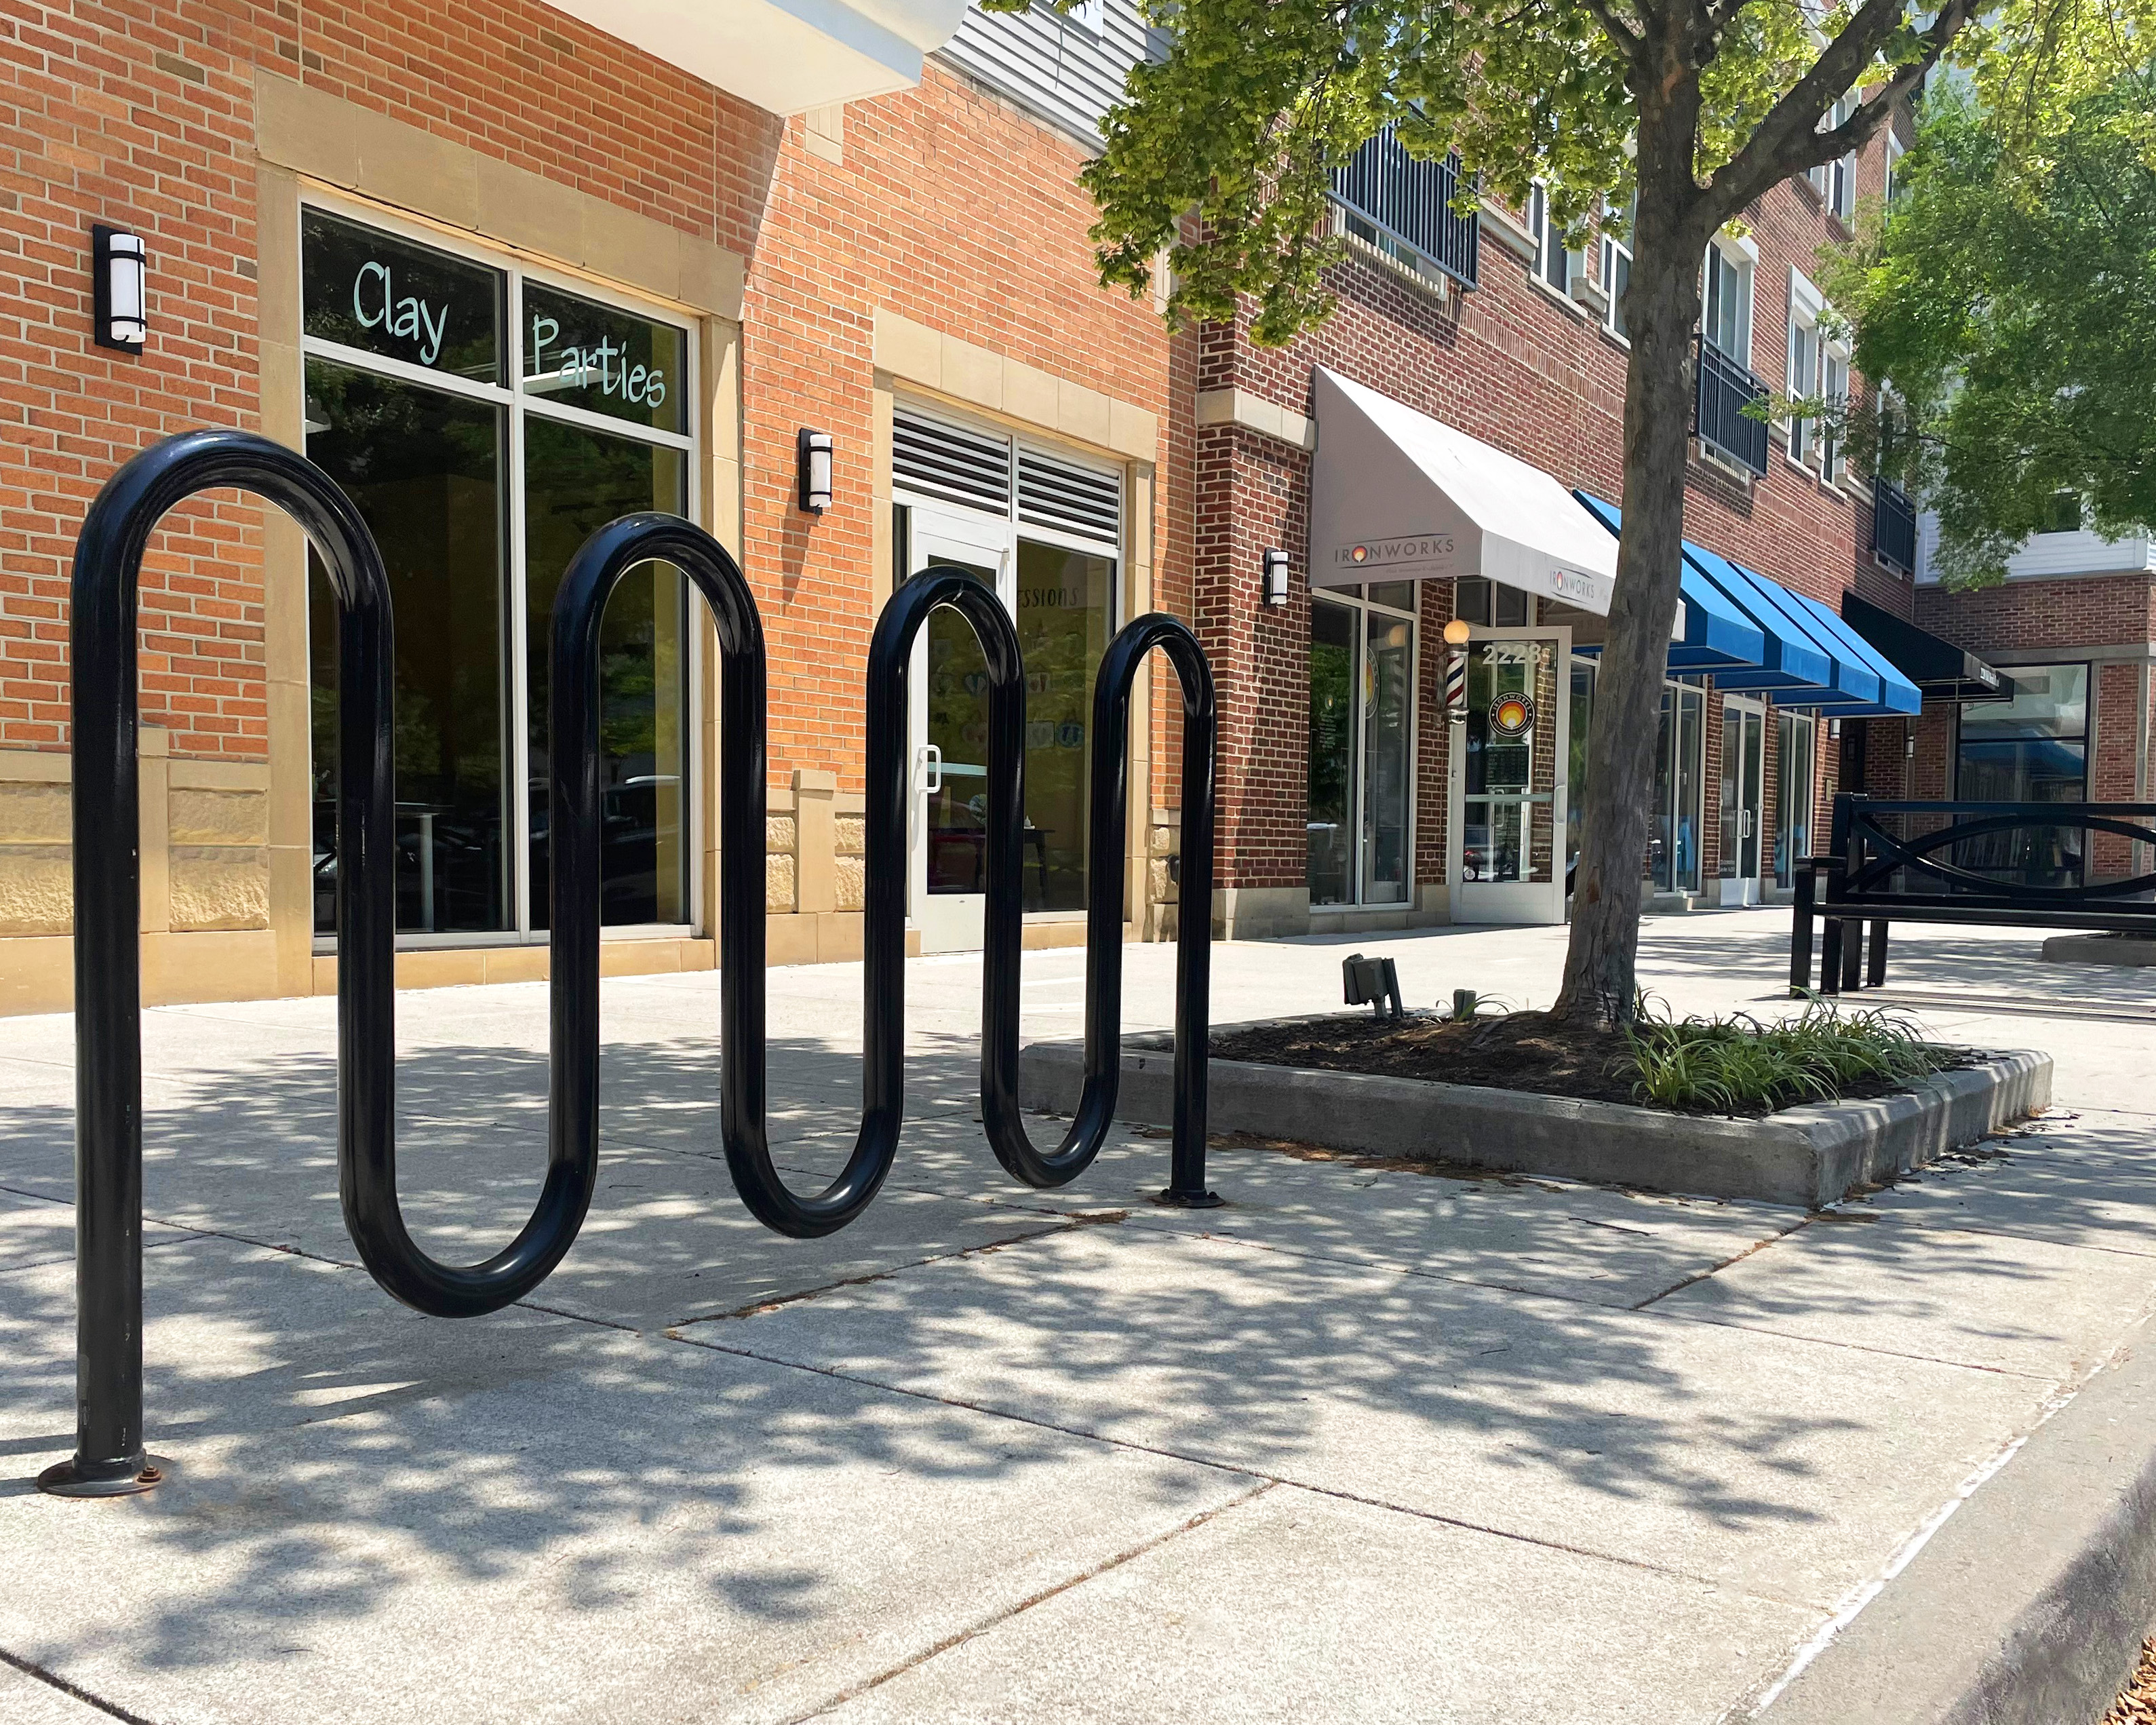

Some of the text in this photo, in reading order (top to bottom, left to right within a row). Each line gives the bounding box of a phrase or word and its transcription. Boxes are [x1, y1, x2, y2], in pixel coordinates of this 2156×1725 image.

[354, 261, 666, 408] Clay Parties
[1335, 539, 1454, 562] IRONWORKS
[1550, 570, 1594, 598] IRONWORKS
[1483, 643, 1542, 665] 2228
[1493, 694, 1532, 710] IRONWORKS
